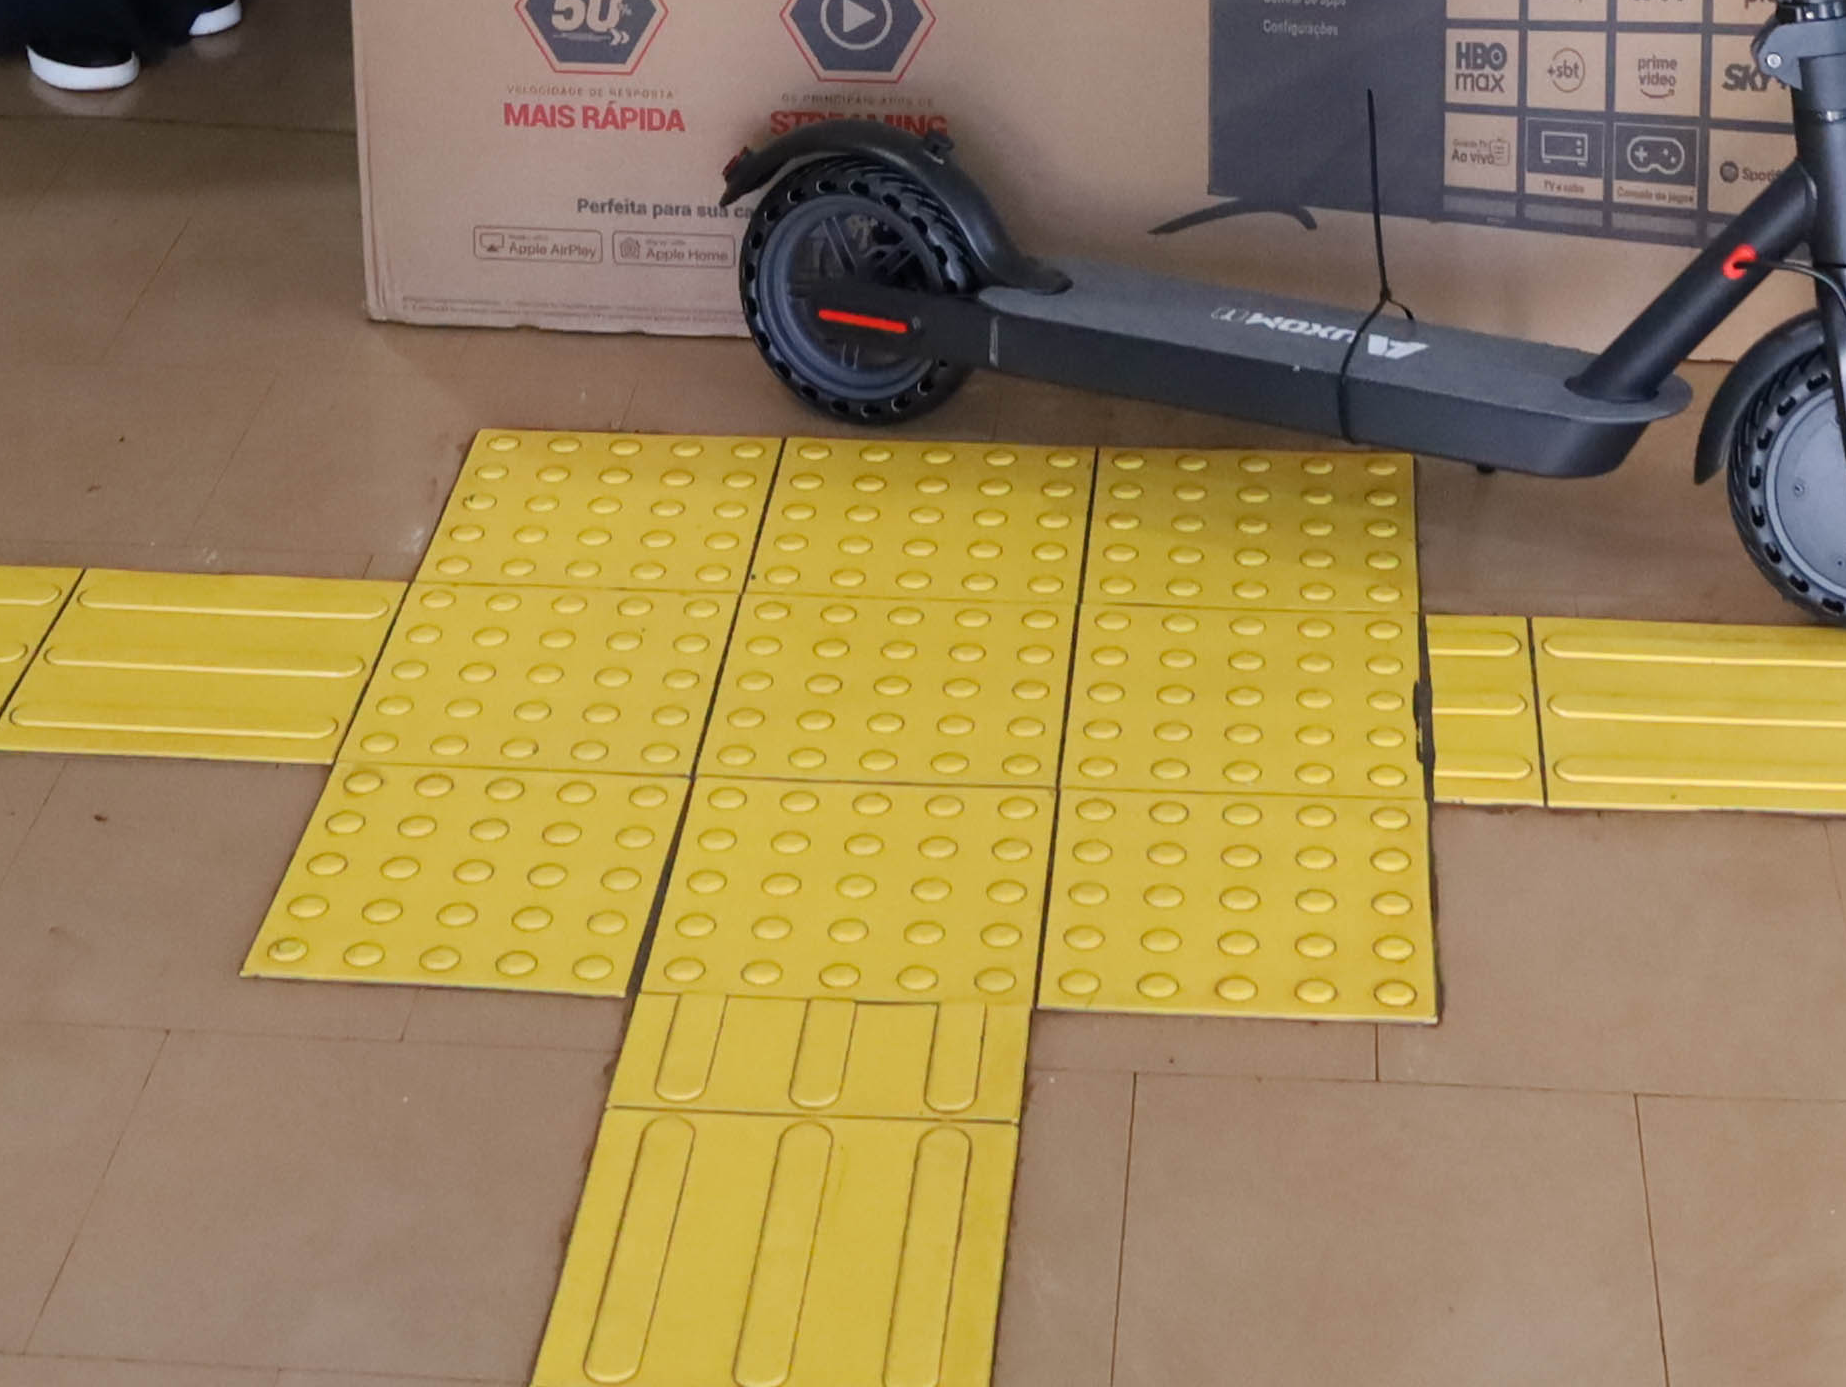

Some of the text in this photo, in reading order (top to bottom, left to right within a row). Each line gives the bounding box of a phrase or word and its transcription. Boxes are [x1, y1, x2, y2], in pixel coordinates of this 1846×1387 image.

[1455, 41, 1508, 71] HBO
[1637, 54, 1678, 71] prime
[1456, 73, 1505, 94] max
[1639, 72, 1676, 87] video
[504, 100, 686, 132] MAIS RÁPIDA
[1452, 148, 1468, 163] Ao
[577, 197, 647, 215] Perfeita
[652, 203, 692, 219] para
[696, 205, 729, 218] sua
[509, 242, 596, 259] Apple AirPlay
[646, 247, 729, 262] Apple Home
